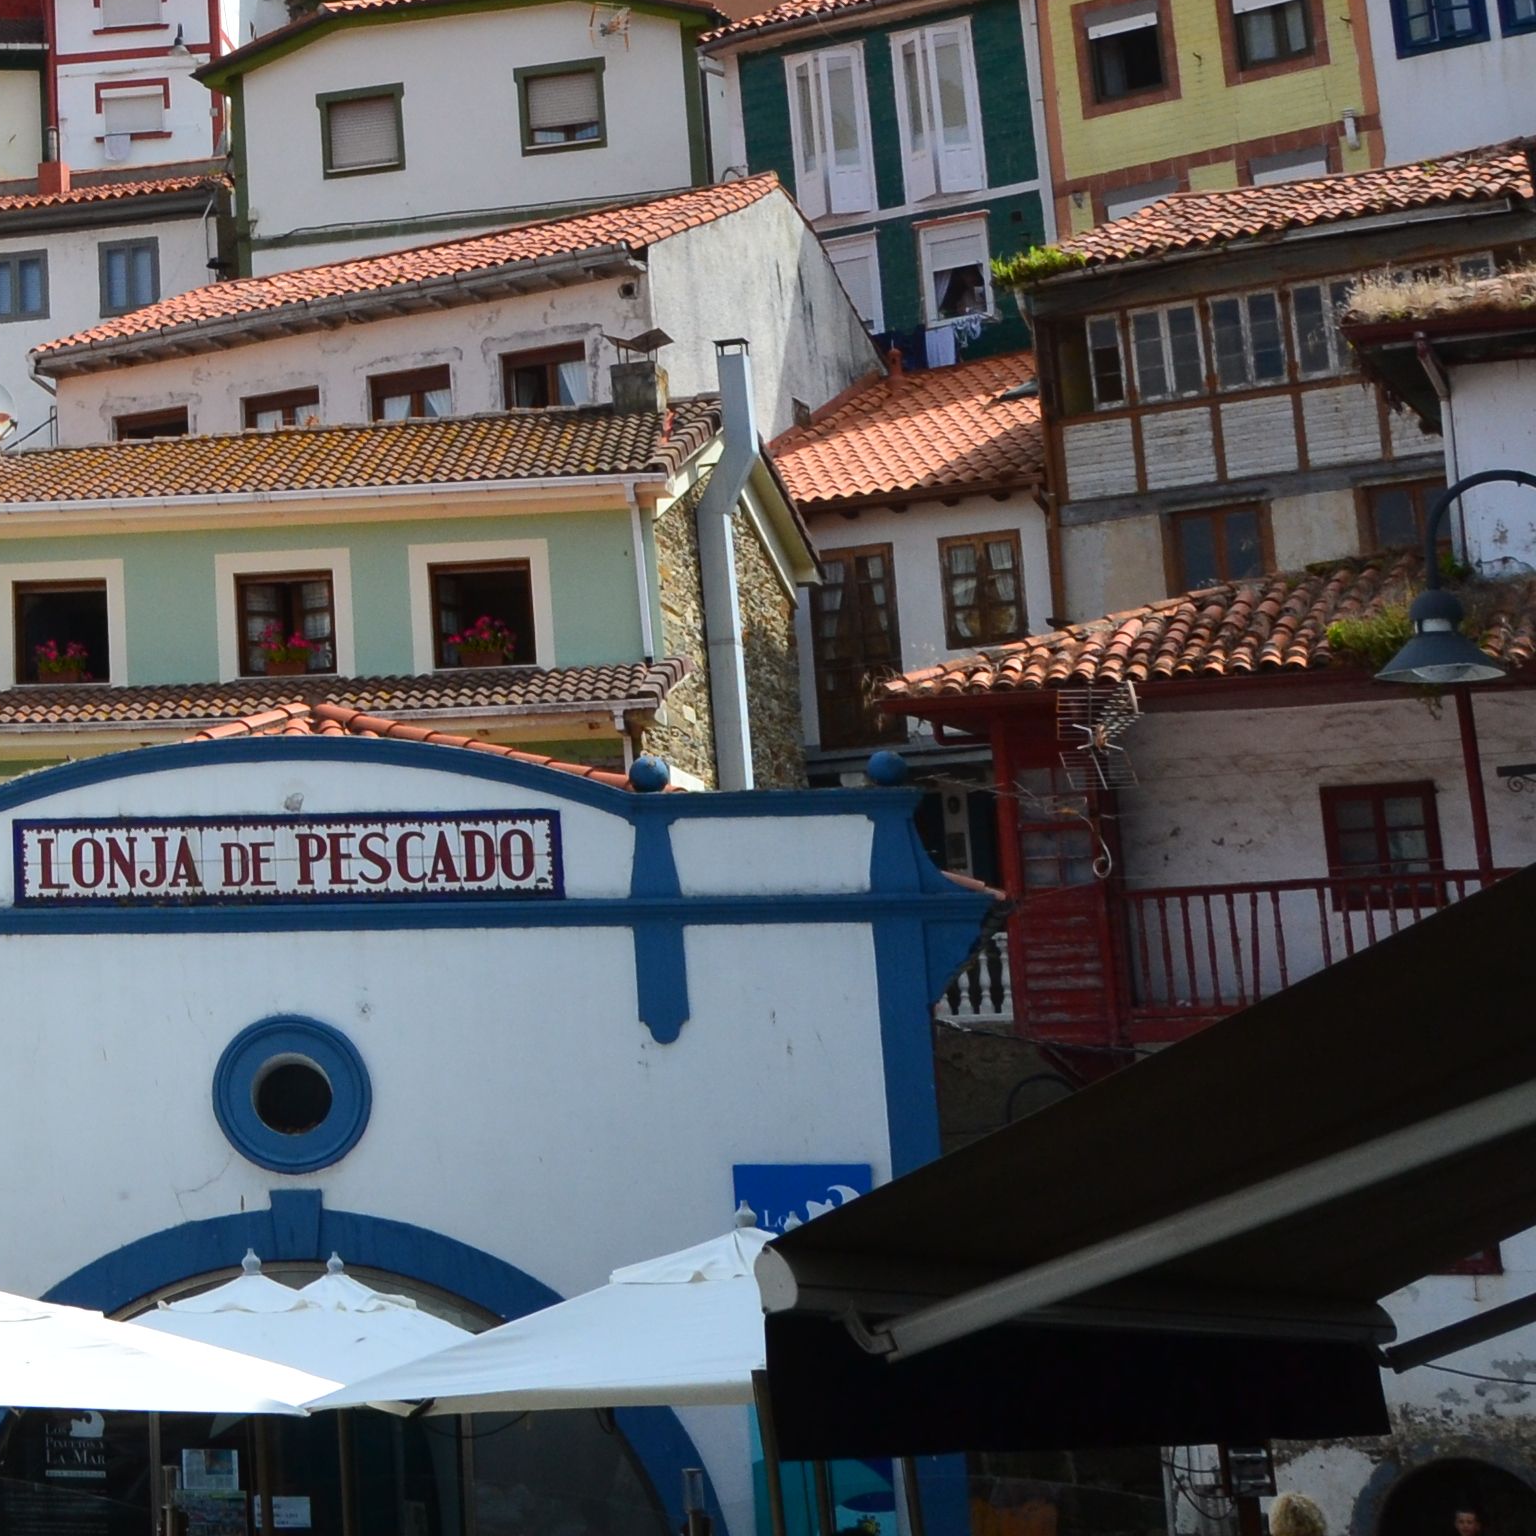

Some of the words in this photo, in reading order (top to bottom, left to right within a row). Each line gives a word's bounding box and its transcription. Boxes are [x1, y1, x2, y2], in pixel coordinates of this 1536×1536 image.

[37, 834, 203, 889] LONJA
[221, 841, 276, 886] DE
[296, 829, 536, 885] PESCADO
